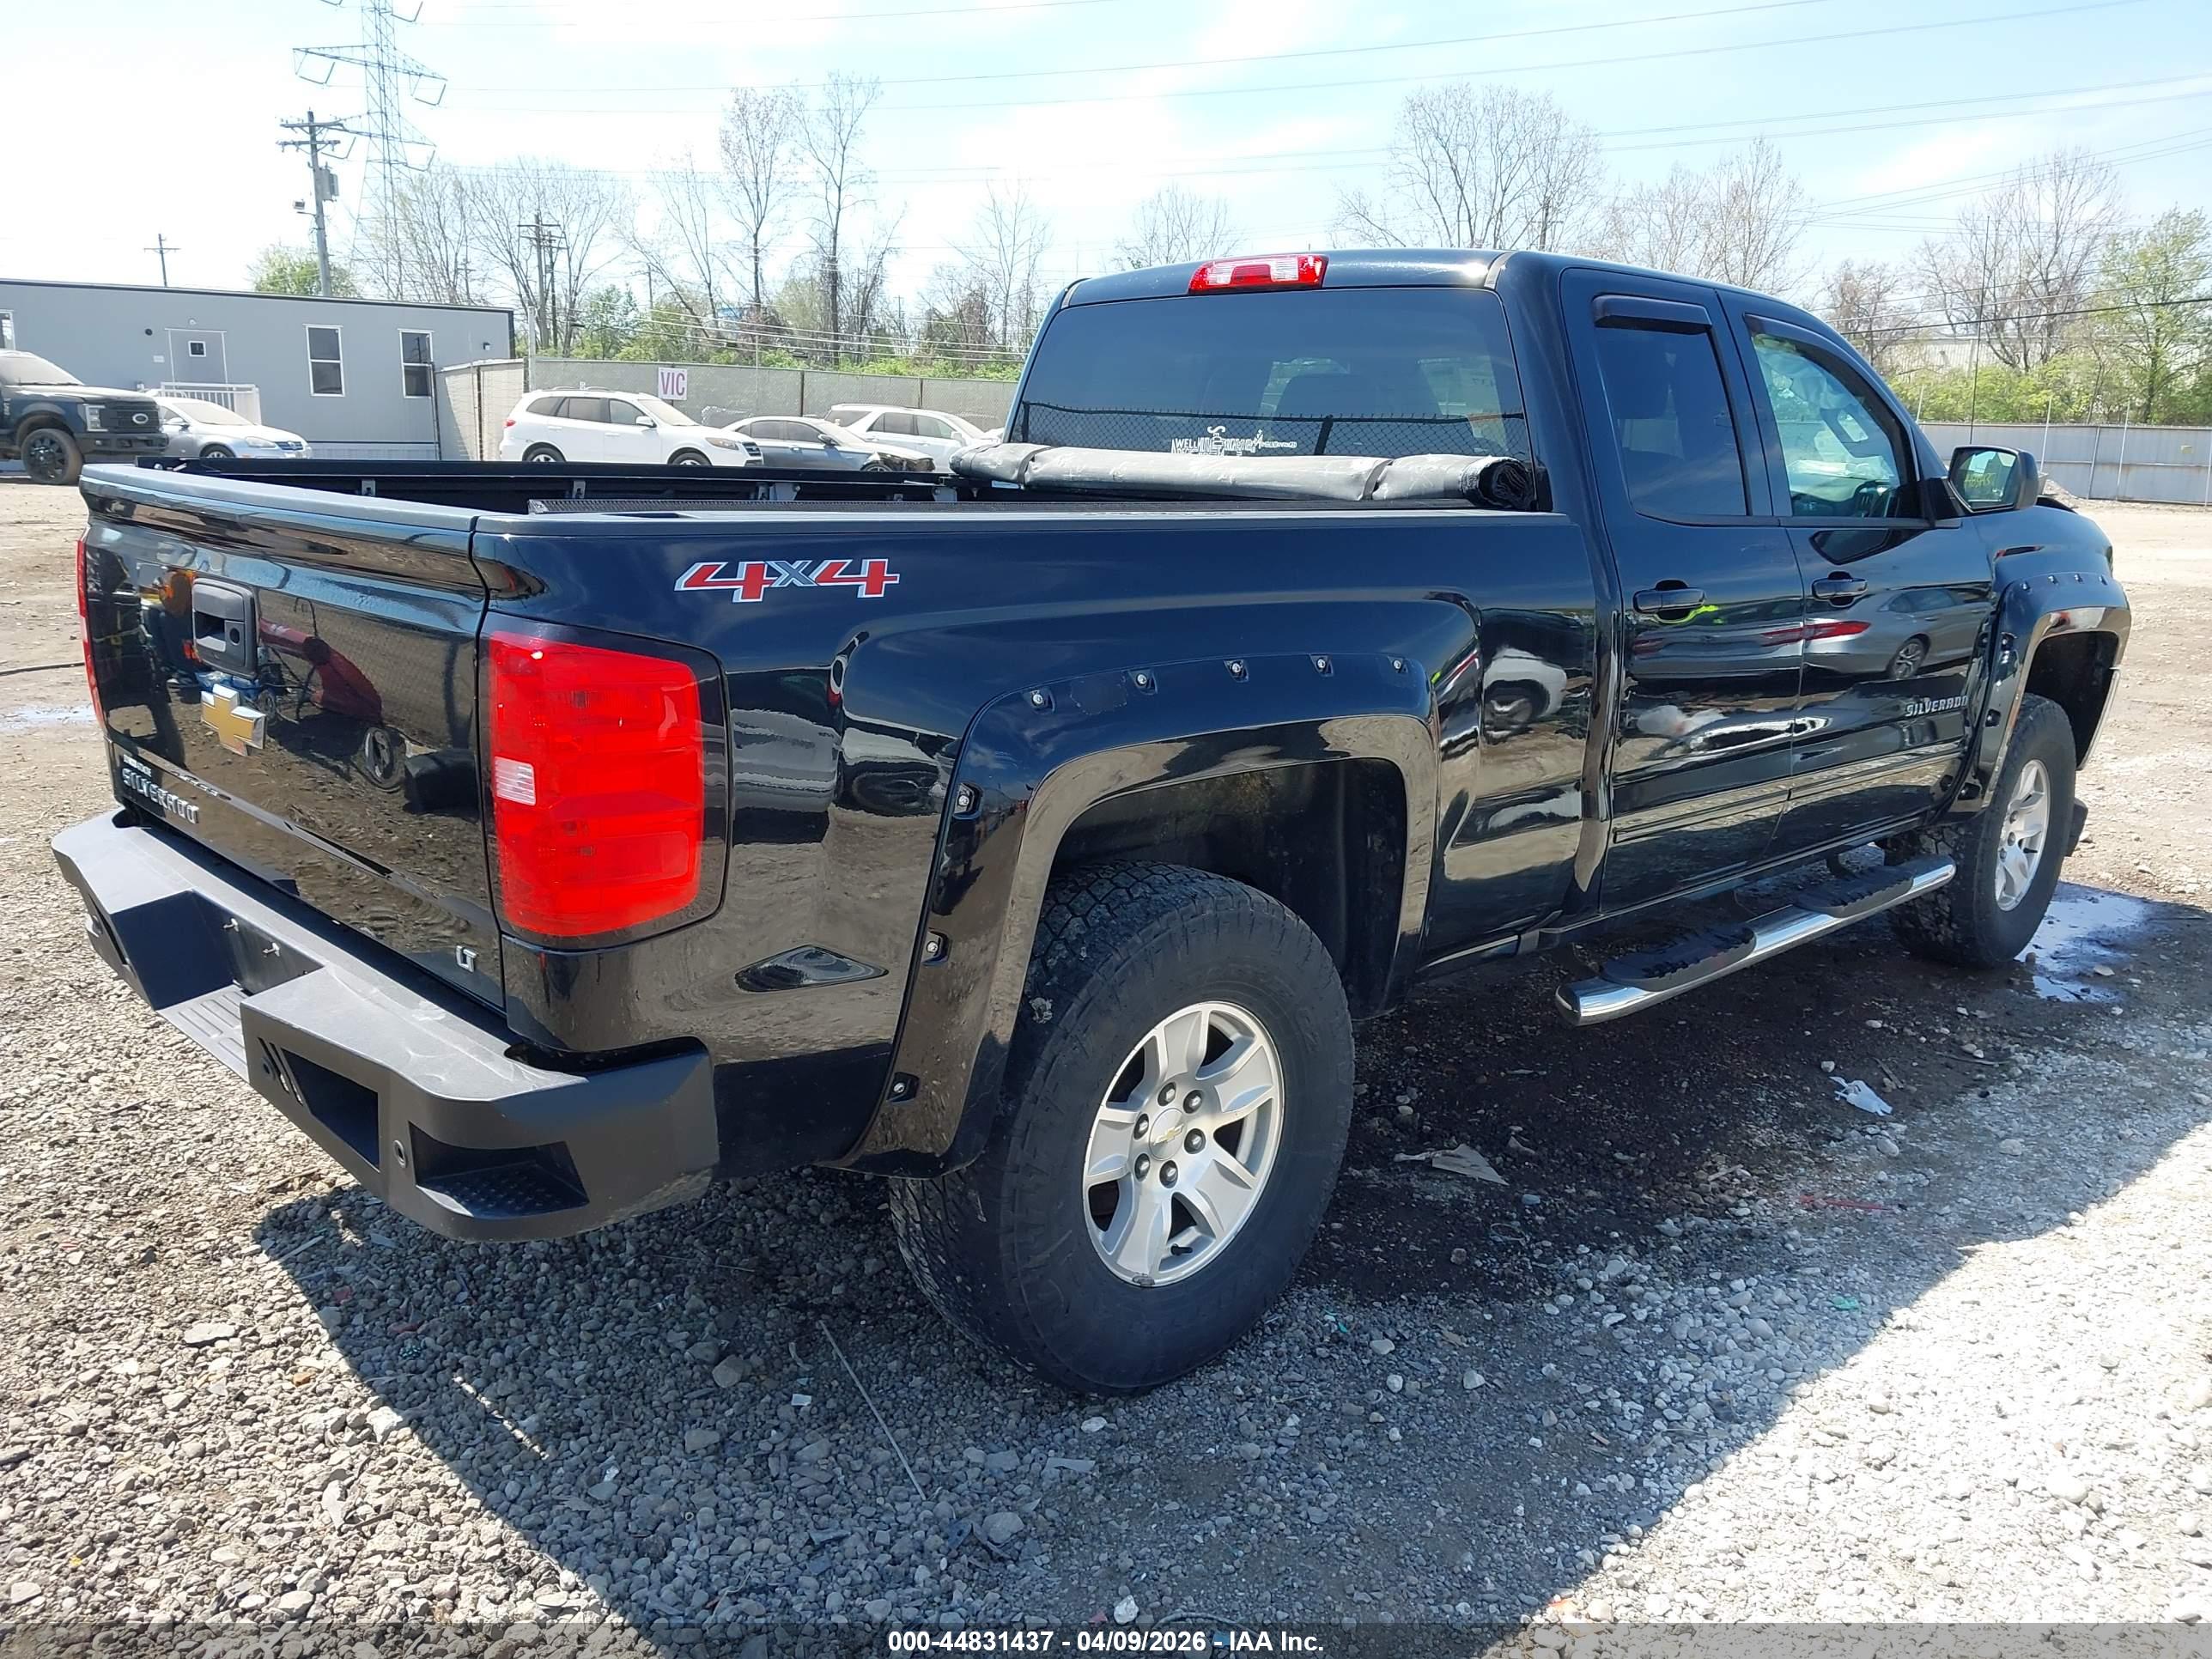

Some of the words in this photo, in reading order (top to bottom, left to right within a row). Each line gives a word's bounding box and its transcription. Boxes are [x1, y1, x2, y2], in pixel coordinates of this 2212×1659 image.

[661, 372, 685, 396] VIC
[1905, 696, 1968, 717] SILVERADO
[122, 768, 199, 824] SILVERADO
[456, 945, 477, 972] LT
